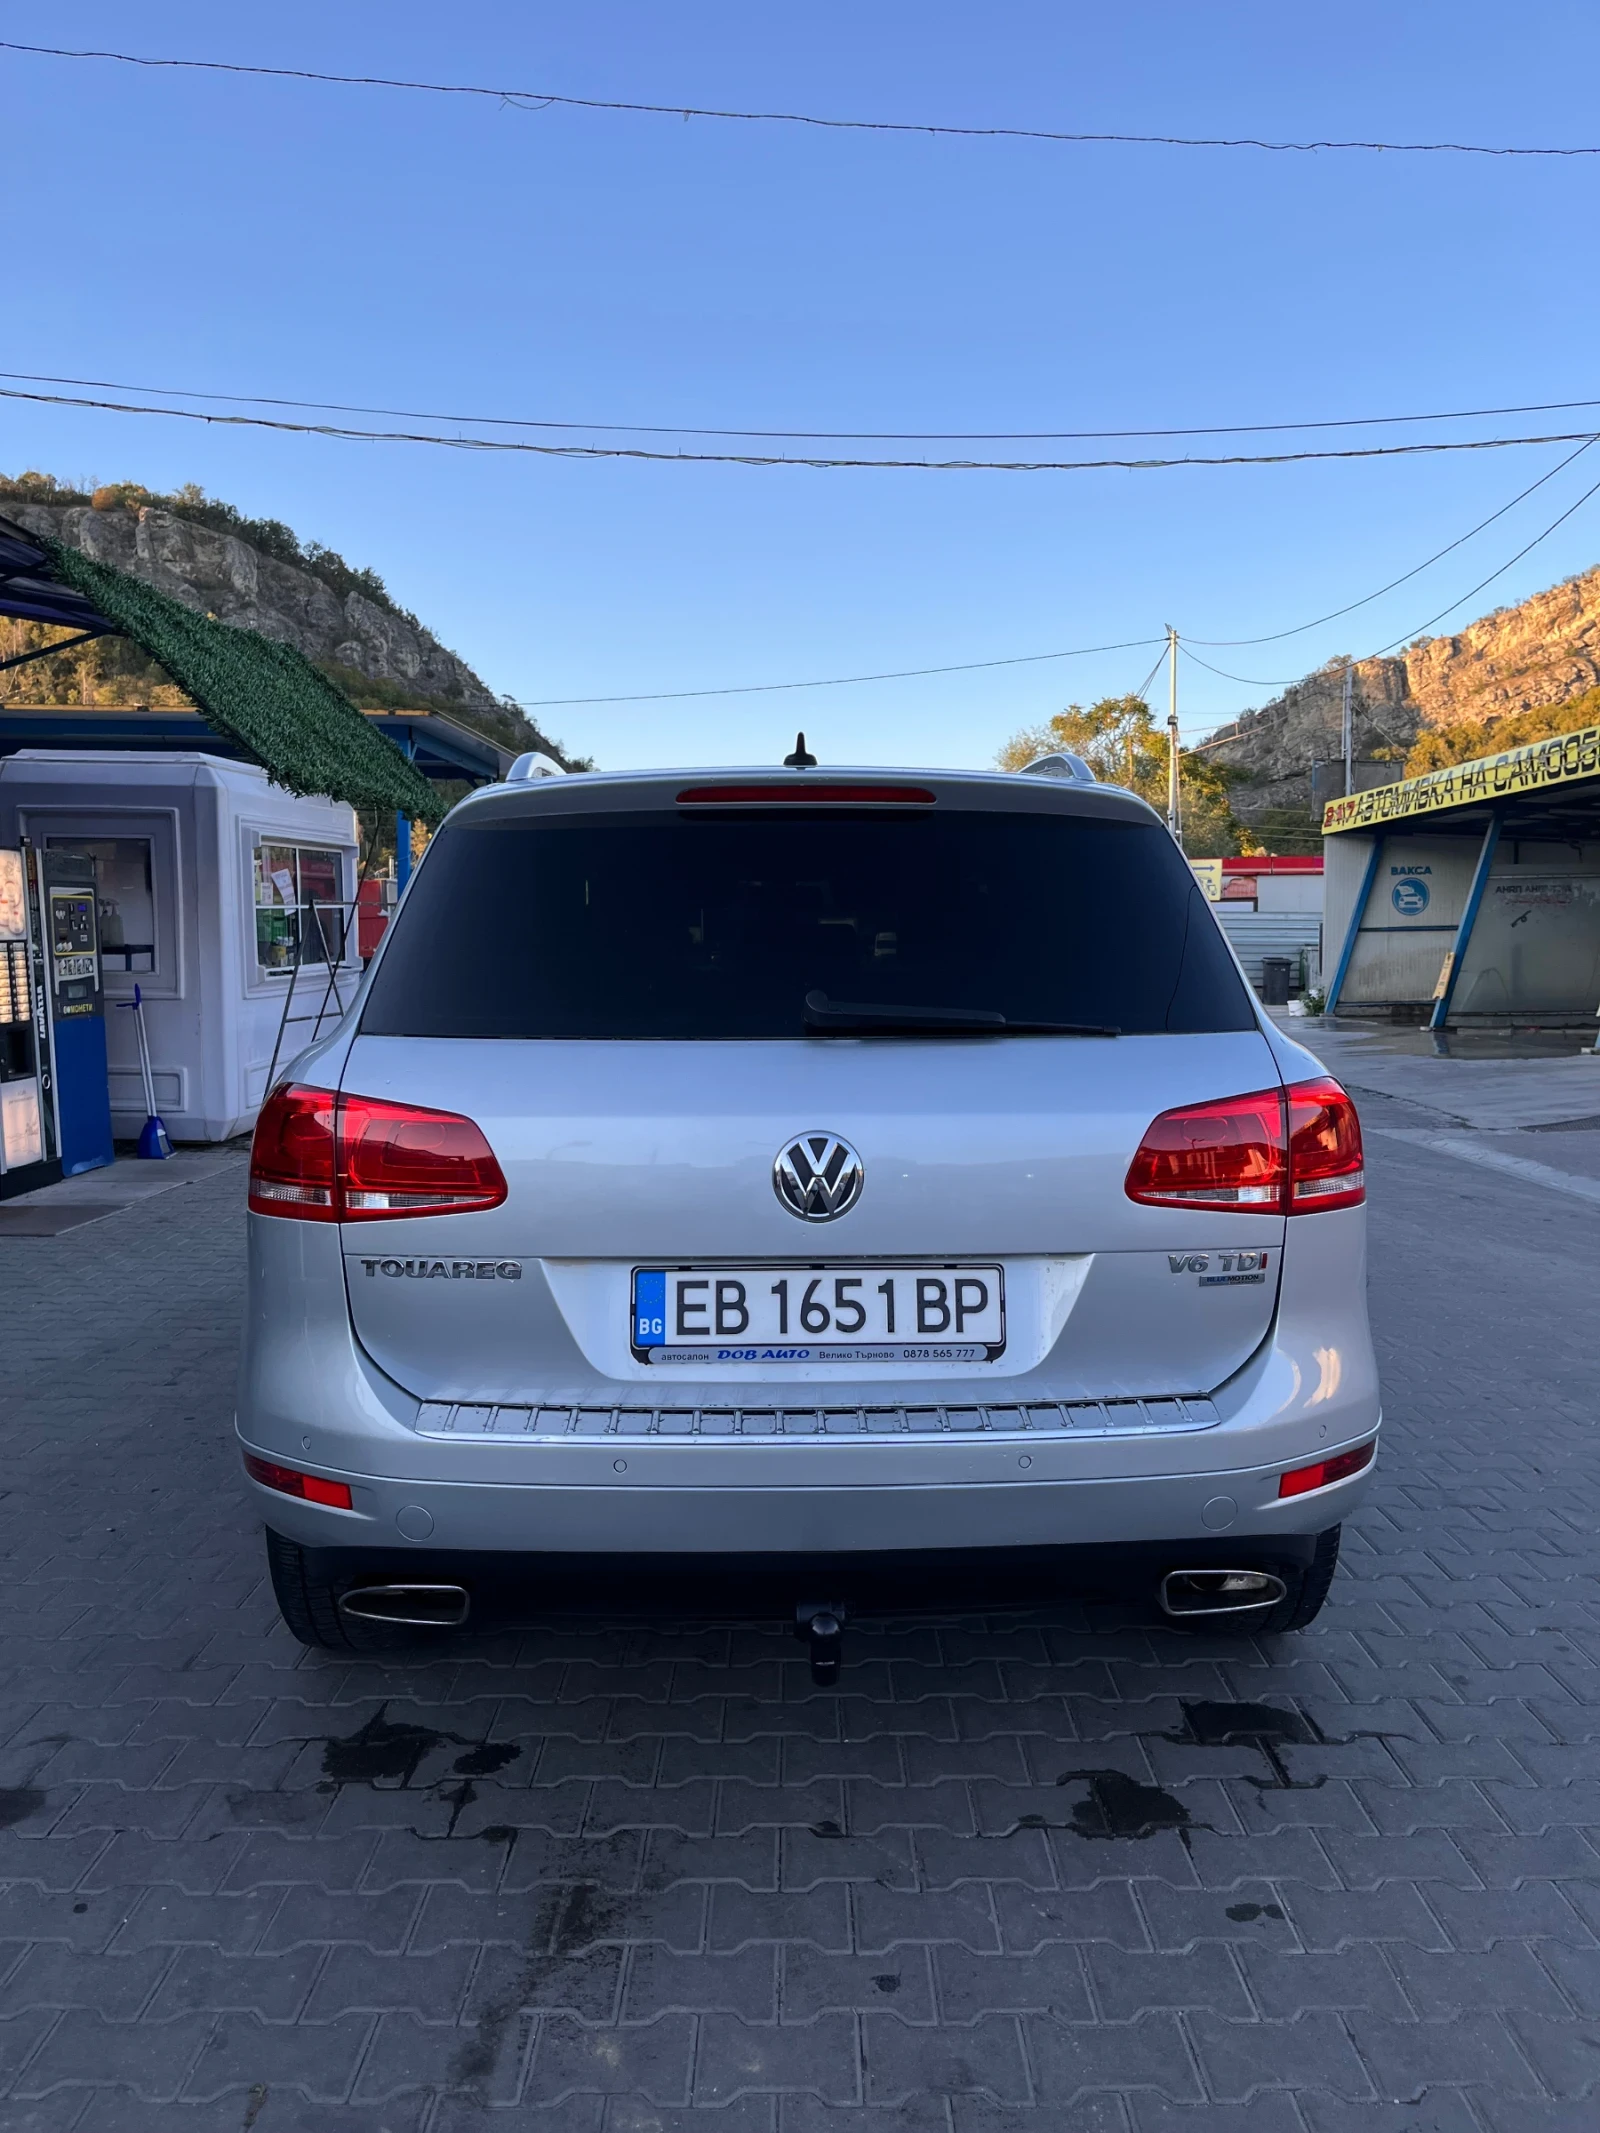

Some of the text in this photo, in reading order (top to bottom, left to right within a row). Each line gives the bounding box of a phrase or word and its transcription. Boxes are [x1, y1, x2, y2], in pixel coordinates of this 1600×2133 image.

[1459, 760, 1488, 801] НА
[1493, 729, 1600, 792] САМООБ
[1390, 866, 1433, 876] ВАКСА
[36, 985, 46, 1039] LAVAZZA
[360, 1259, 523, 1280] TOUAREG
[1168, 1251, 1268, 1273] V6 TDI
[676, 1278, 989, 1336] EB 1651 BP
[639, 1317, 662, 1334] BG
[661, 1352, 709, 1361] автосалон
[717, 1349, 758, 1360] DOB
[819, 1351, 852, 1359] Велико
[855, 1351, 895, 1361] Търново
[903, 1349, 930, 1358] 0878
[933, 1349, 952, 1358] 565
[956, 1349, 975, 1358] 777
